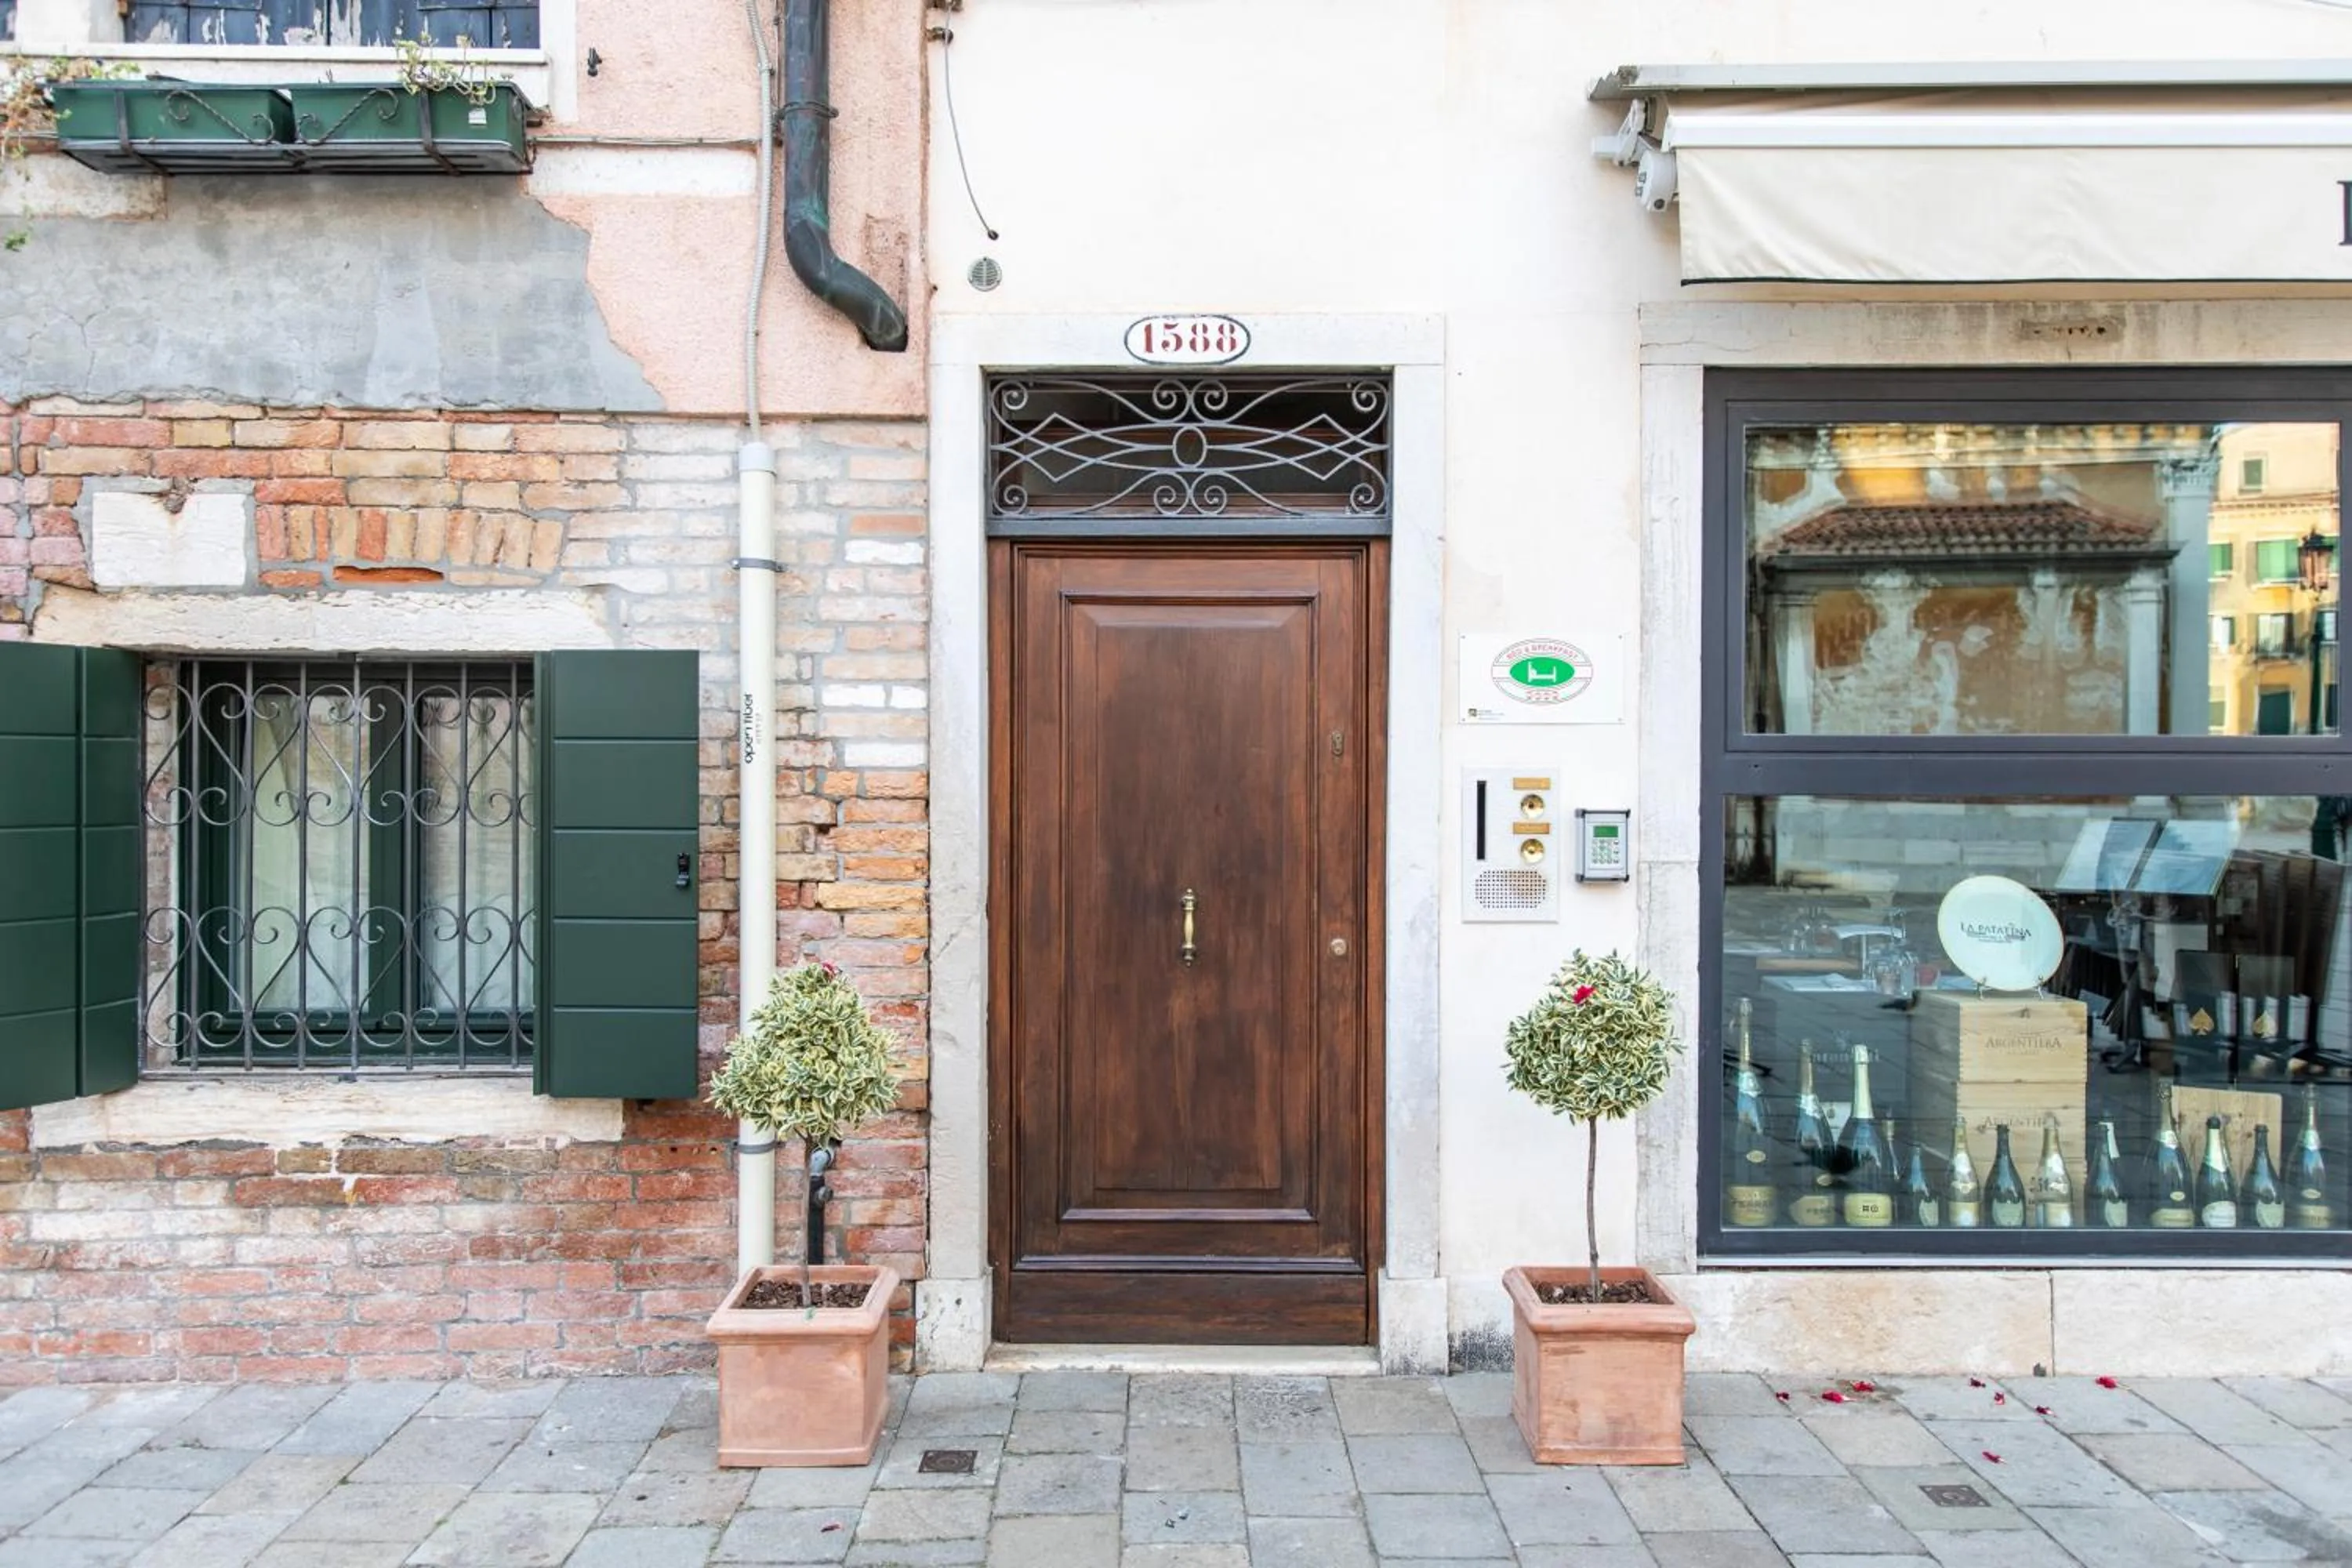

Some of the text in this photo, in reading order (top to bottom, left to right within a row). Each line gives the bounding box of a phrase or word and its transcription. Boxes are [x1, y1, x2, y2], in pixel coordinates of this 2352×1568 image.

[1143, 322, 1237, 354] 1588
[744, 727, 755, 764] open
[1961, 921, 1974, 932] LA
